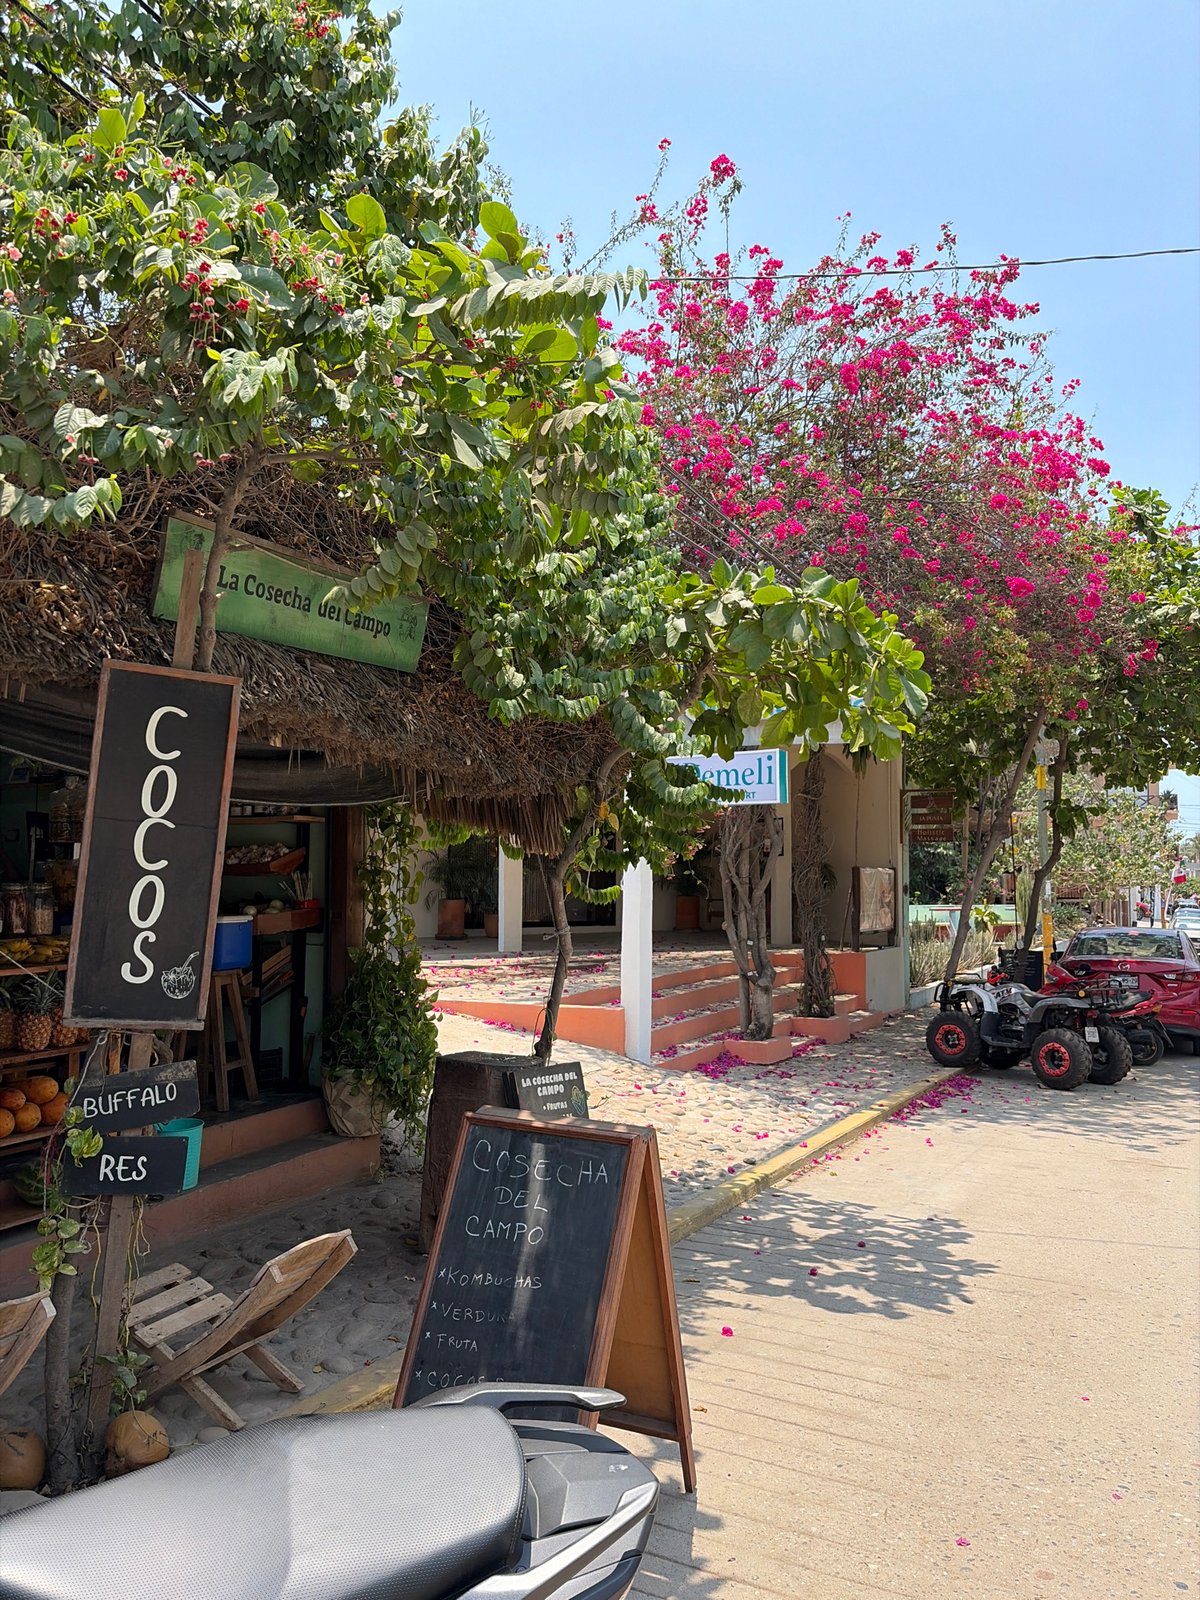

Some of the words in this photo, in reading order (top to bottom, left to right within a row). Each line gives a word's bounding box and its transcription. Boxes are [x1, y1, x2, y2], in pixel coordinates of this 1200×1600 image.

[217, 565, 240, 591] La
[244, 574, 311, 613] Cosecha
[317, 601, 341, 622] del
[344, 610, 391, 638] Campo
[121, 706, 188, 984] COCOS
[521, 1078, 532, 1088] LA
[532, 1073, 564, 1085] COSECHA
[564, 1071, 578, 1079] DEL
[537, 1084, 565, 1097] CAMPO
[83, 1082, 177, 1118] BUFFALO
[546, 1101, 568, 1111] FRUTAS
[99, 1154, 148, 1182] RES
[472, 1139, 609, 1187] COSECHA
[494, 1186, 549, 1213] DEL
[465, 1215, 544, 1245] CAMPO
[446, 1267, 542, 1289] KOMBUCHAS
[437, 1333, 478, 1352] FRUTA
